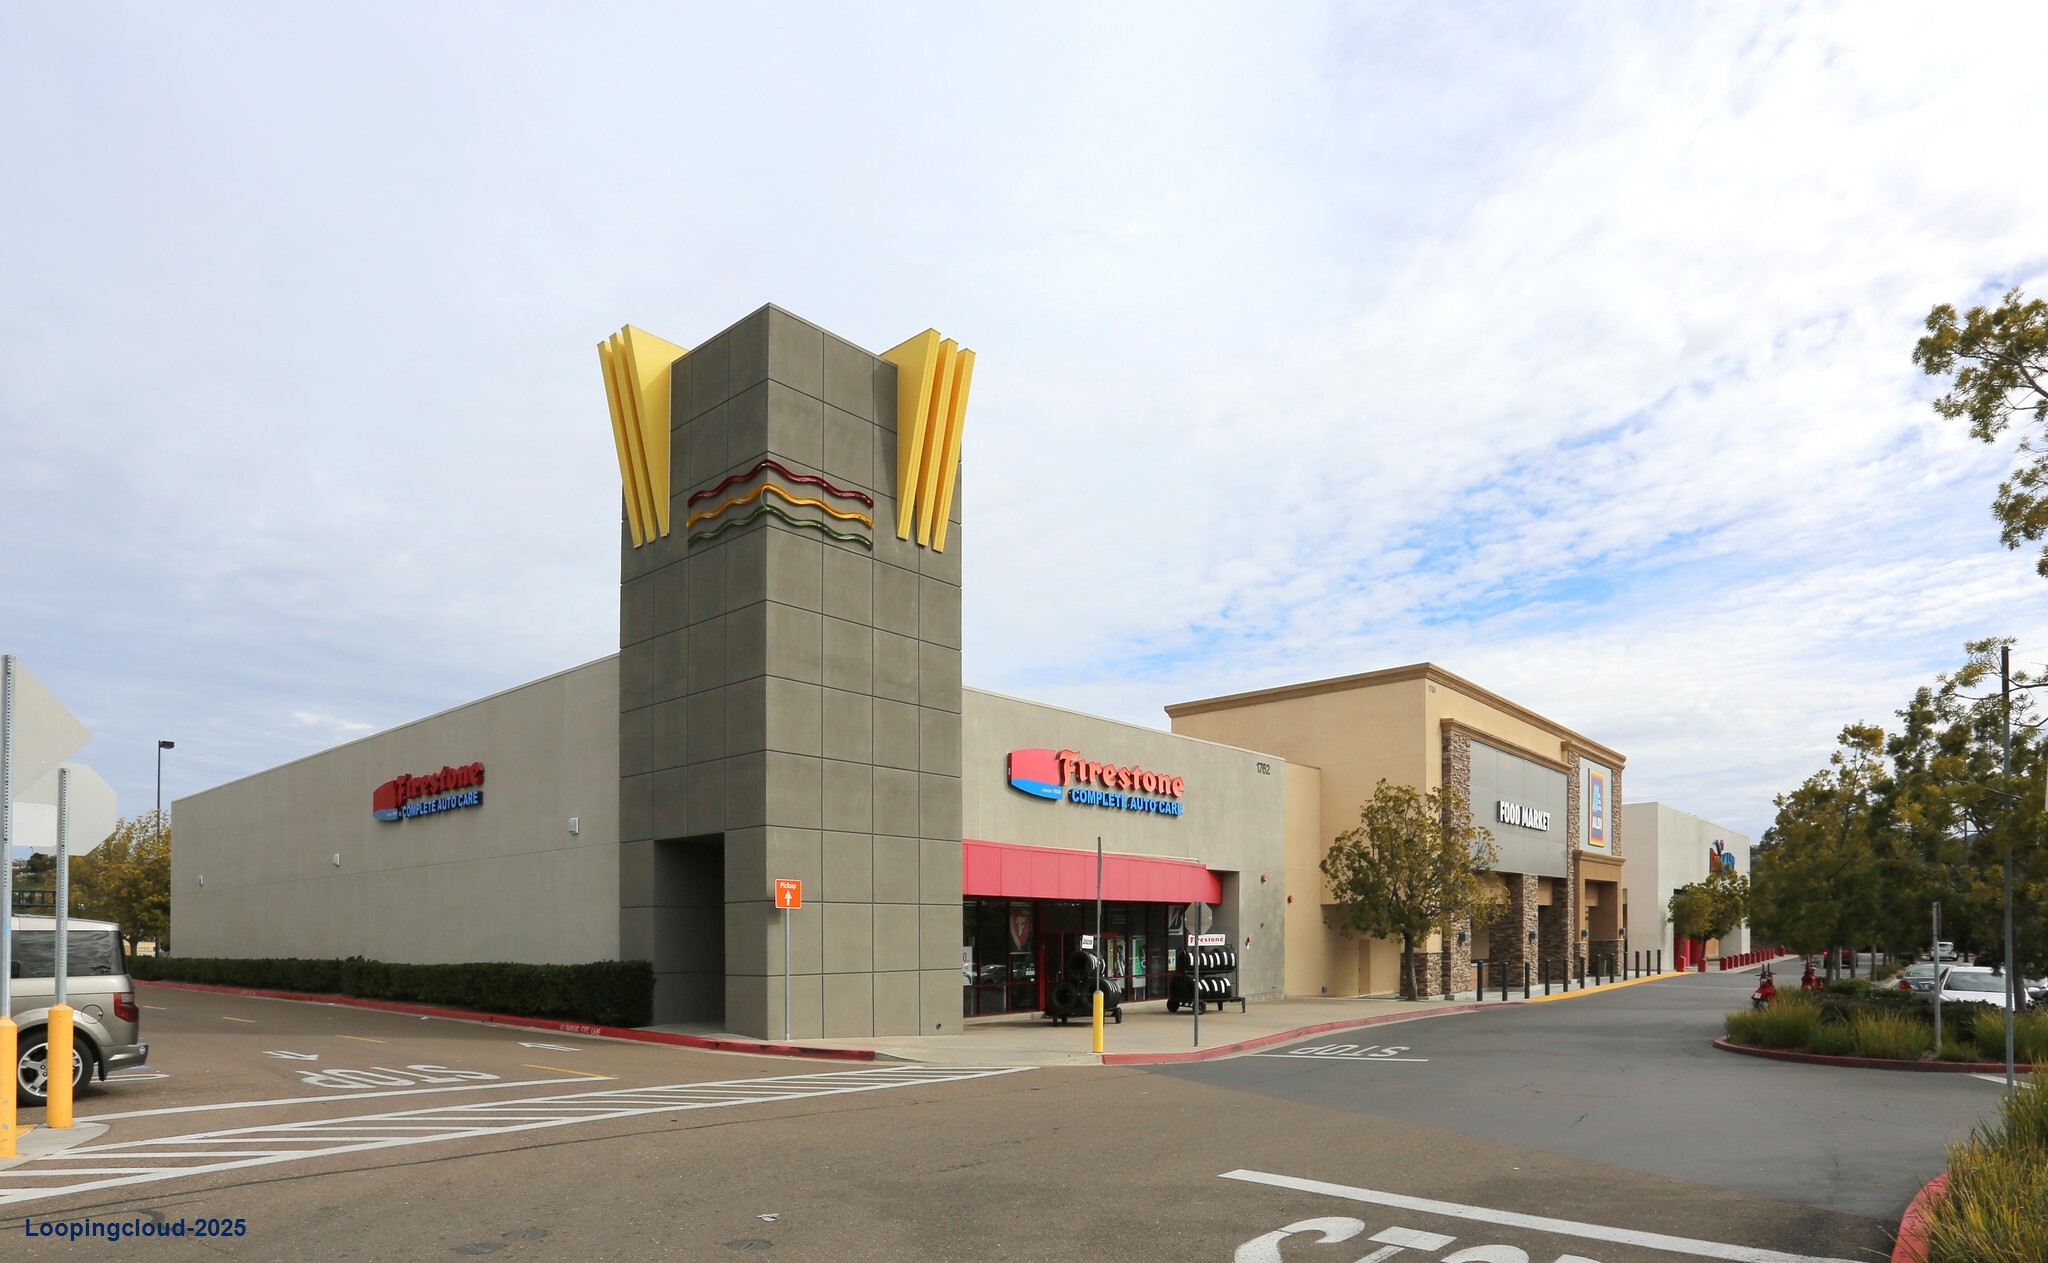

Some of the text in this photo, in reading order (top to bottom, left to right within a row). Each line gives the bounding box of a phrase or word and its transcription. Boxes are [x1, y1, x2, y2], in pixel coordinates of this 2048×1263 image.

[1056, 749, 1185, 797] Firestone
[1256, 762, 1270, 775] 1762
[395, 762, 485, 806] Firestone
[402, 791, 479, 818] COMPLETE AUTO CARE
[1071, 788, 1184, 816] COMPLETE AUTO CARE
[1499, 800, 1550, 831] FOOD MARKET
[780, 881, 797, 890] Pickup
[1288, 1043, 1411, 1058] STOP
[295, 1064, 500, 1089] STOP
